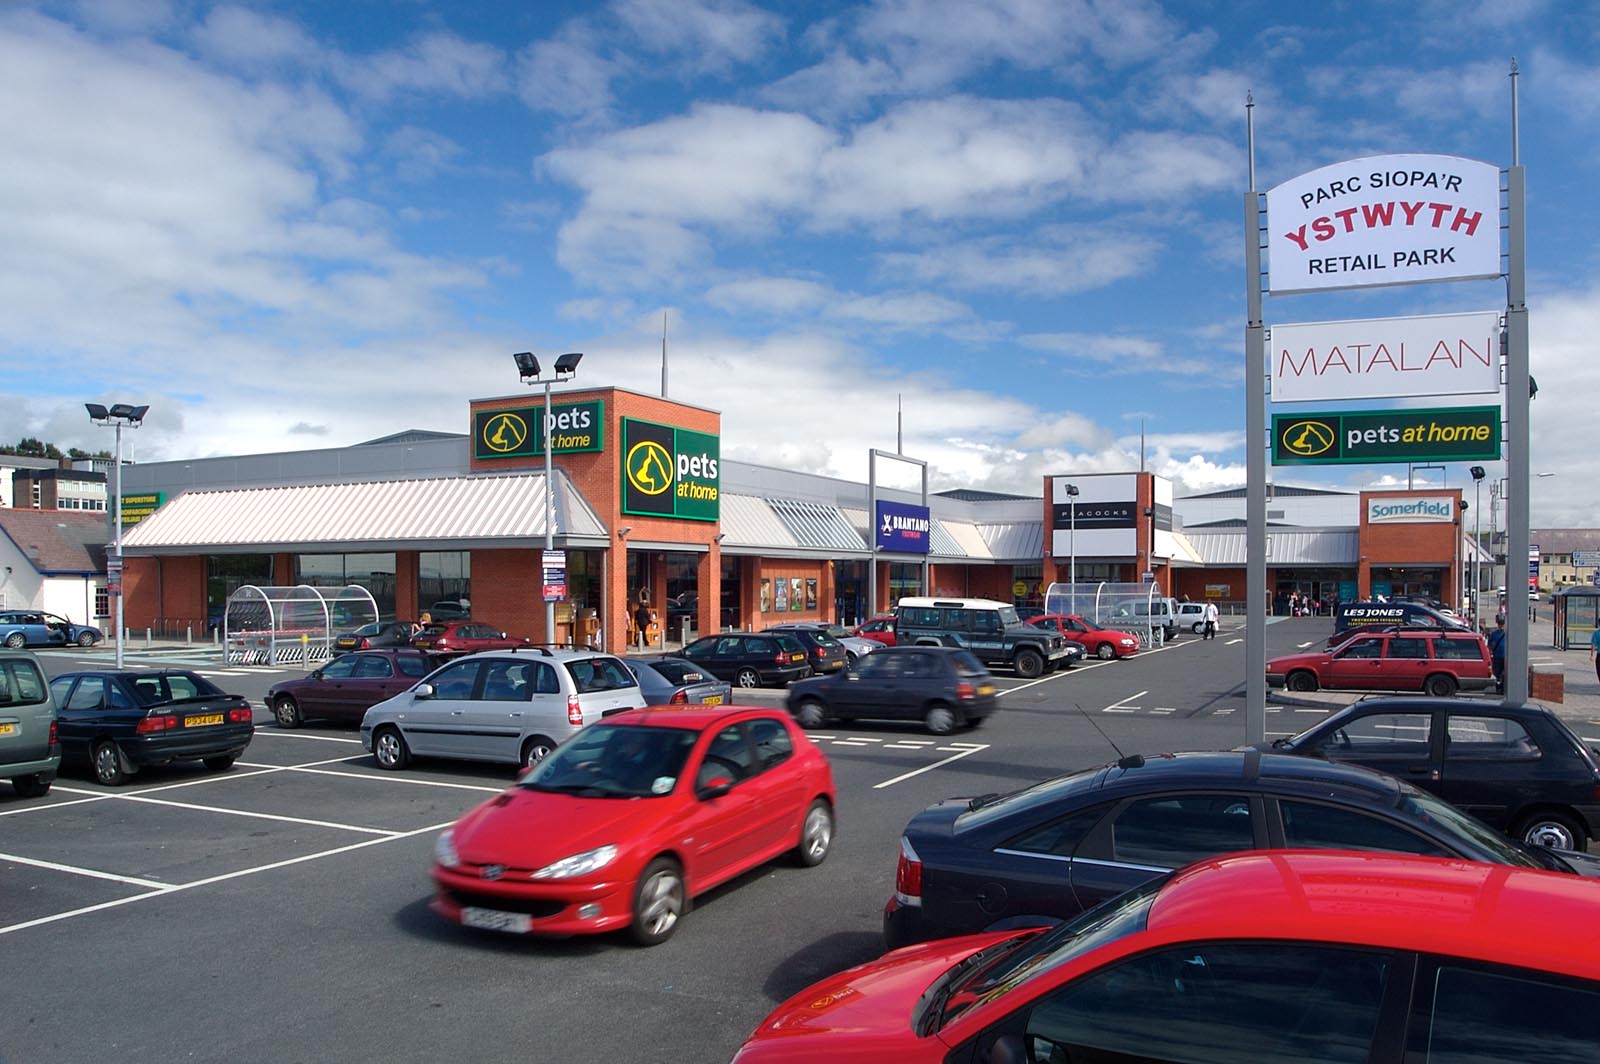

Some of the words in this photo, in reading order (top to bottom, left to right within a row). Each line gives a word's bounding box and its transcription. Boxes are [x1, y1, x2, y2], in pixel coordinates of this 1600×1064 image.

[1300, 176, 1362, 209] PARC
[1369, 170, 1463, 193] SIOPA'R
[1284, 201, 1483, 252] YSTWYTH
[1308, 254, 1386, 275] RETAIL
[1393, 247, 1456, 268] PARK
[1279, 336, 1491, 378] MATALAN
[543, 435, 557, 449] t
[557, 433, 591, 448] home
[1347, 425, 1400, 449] pets
[1402, 424, 1426, 443] at
[1427, 422, 1490, 442] home
[677, 452, 718, 482] pets
[677, 482, 689, 497] at
[690, 480, 718, 500] home
[1371, 500, 1450, 518] Somerfield
[893, 515, 929, 533] BRANTANO
[1343, 609, 1365, 617] LES
[1366, 609, 1404, 617] JONES
